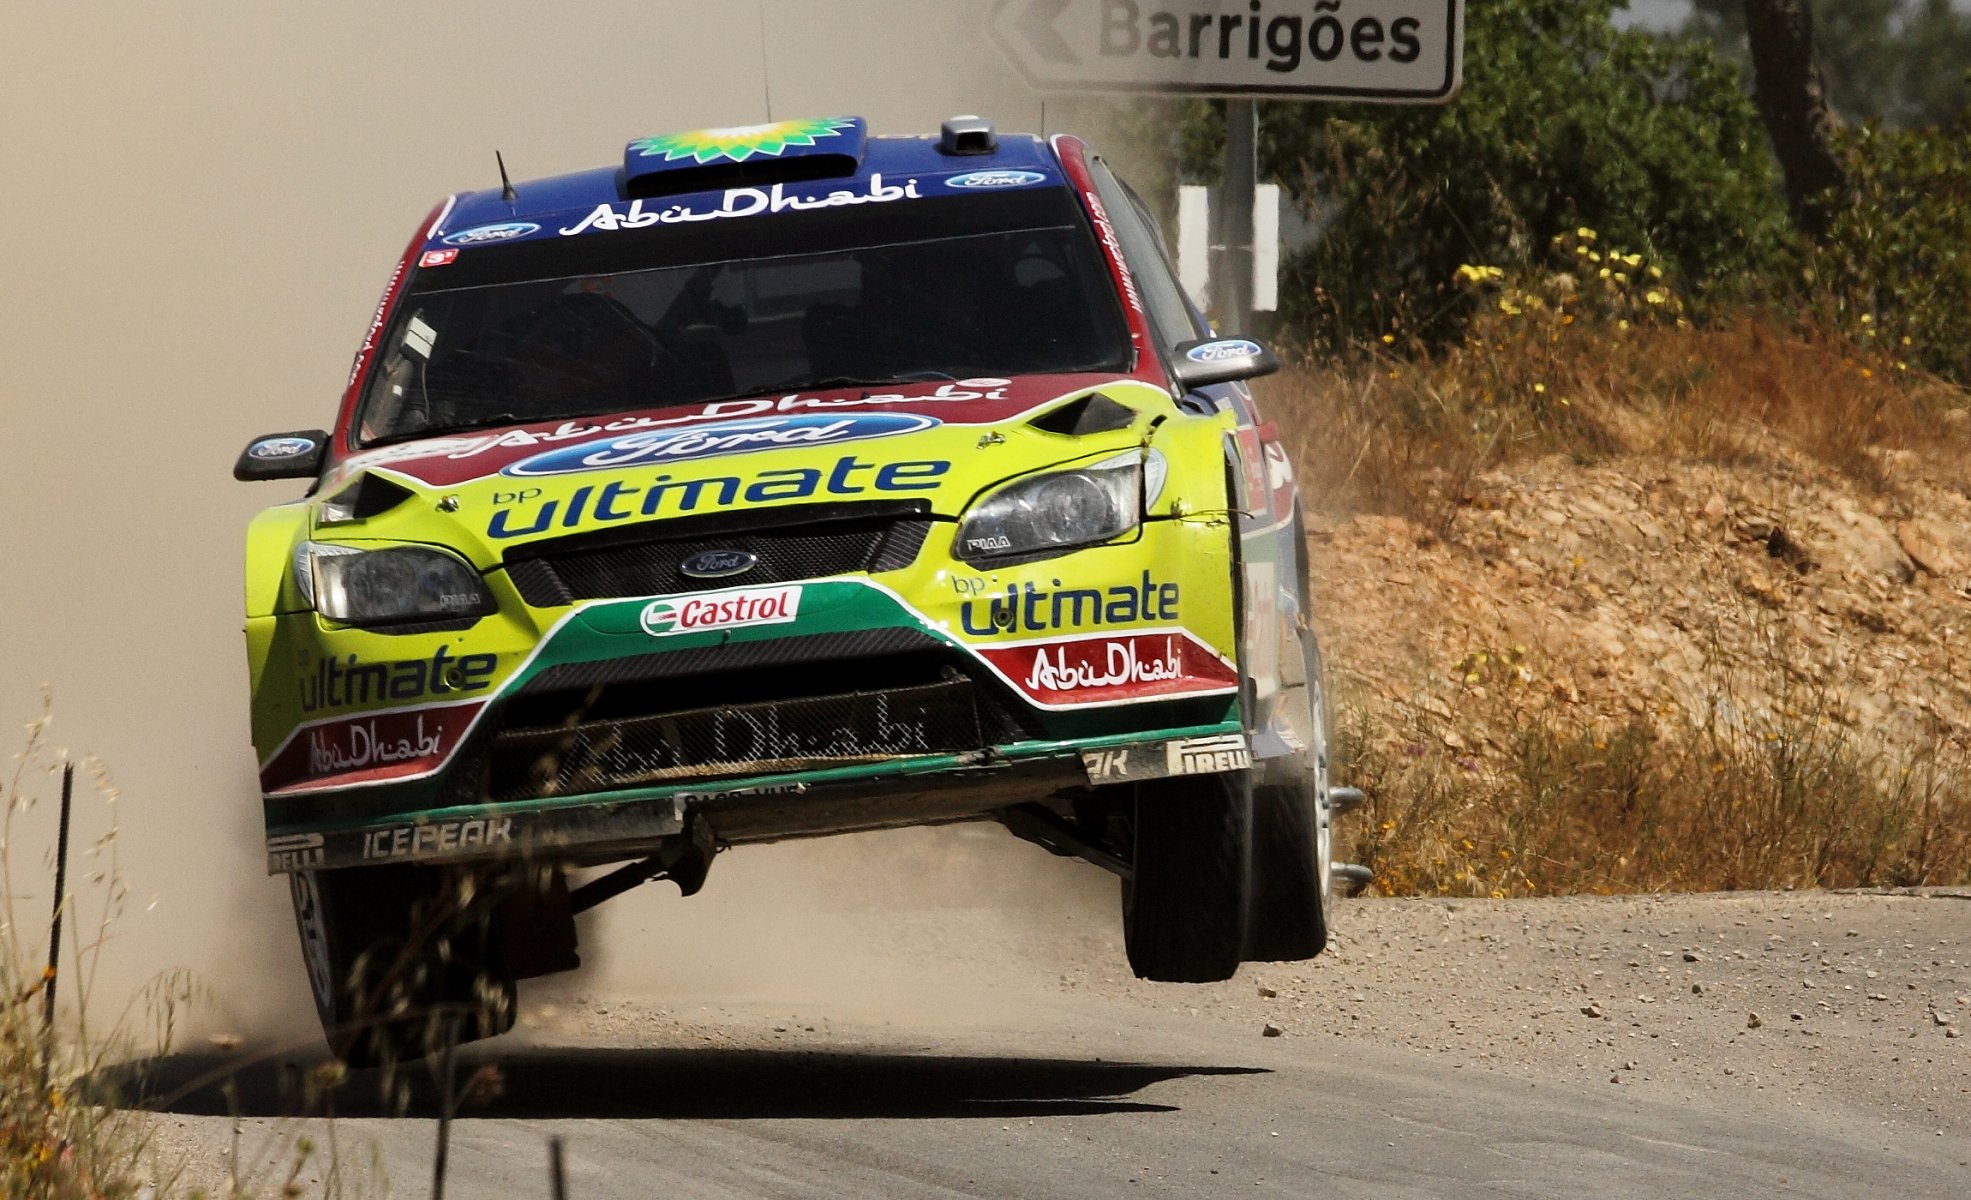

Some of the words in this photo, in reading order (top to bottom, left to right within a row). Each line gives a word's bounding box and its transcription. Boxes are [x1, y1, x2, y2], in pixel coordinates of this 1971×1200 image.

[1099, 0, 1421, 73] Barrigões
[964, 173, 1028, 186] Ford
[1202, 343, 1250, 360] Ford
[257, 441, 304, 457] Ford
[583, 420, 857, 465] Ford
[487, 456, 951, 539] ultimate
[493, 487, 542, 505] bp
[967, 536, 1011, 551] PIAA
[696, 553, 739, 571] Ford
[952, 575, 985, 595] bp
[681, 592, 788, 628] Castrol
[961, 569, 1179, 636] ultimate
[301, 644, 498, 712] ultimate
[363, 818, 513, 860] ICEPEAK
